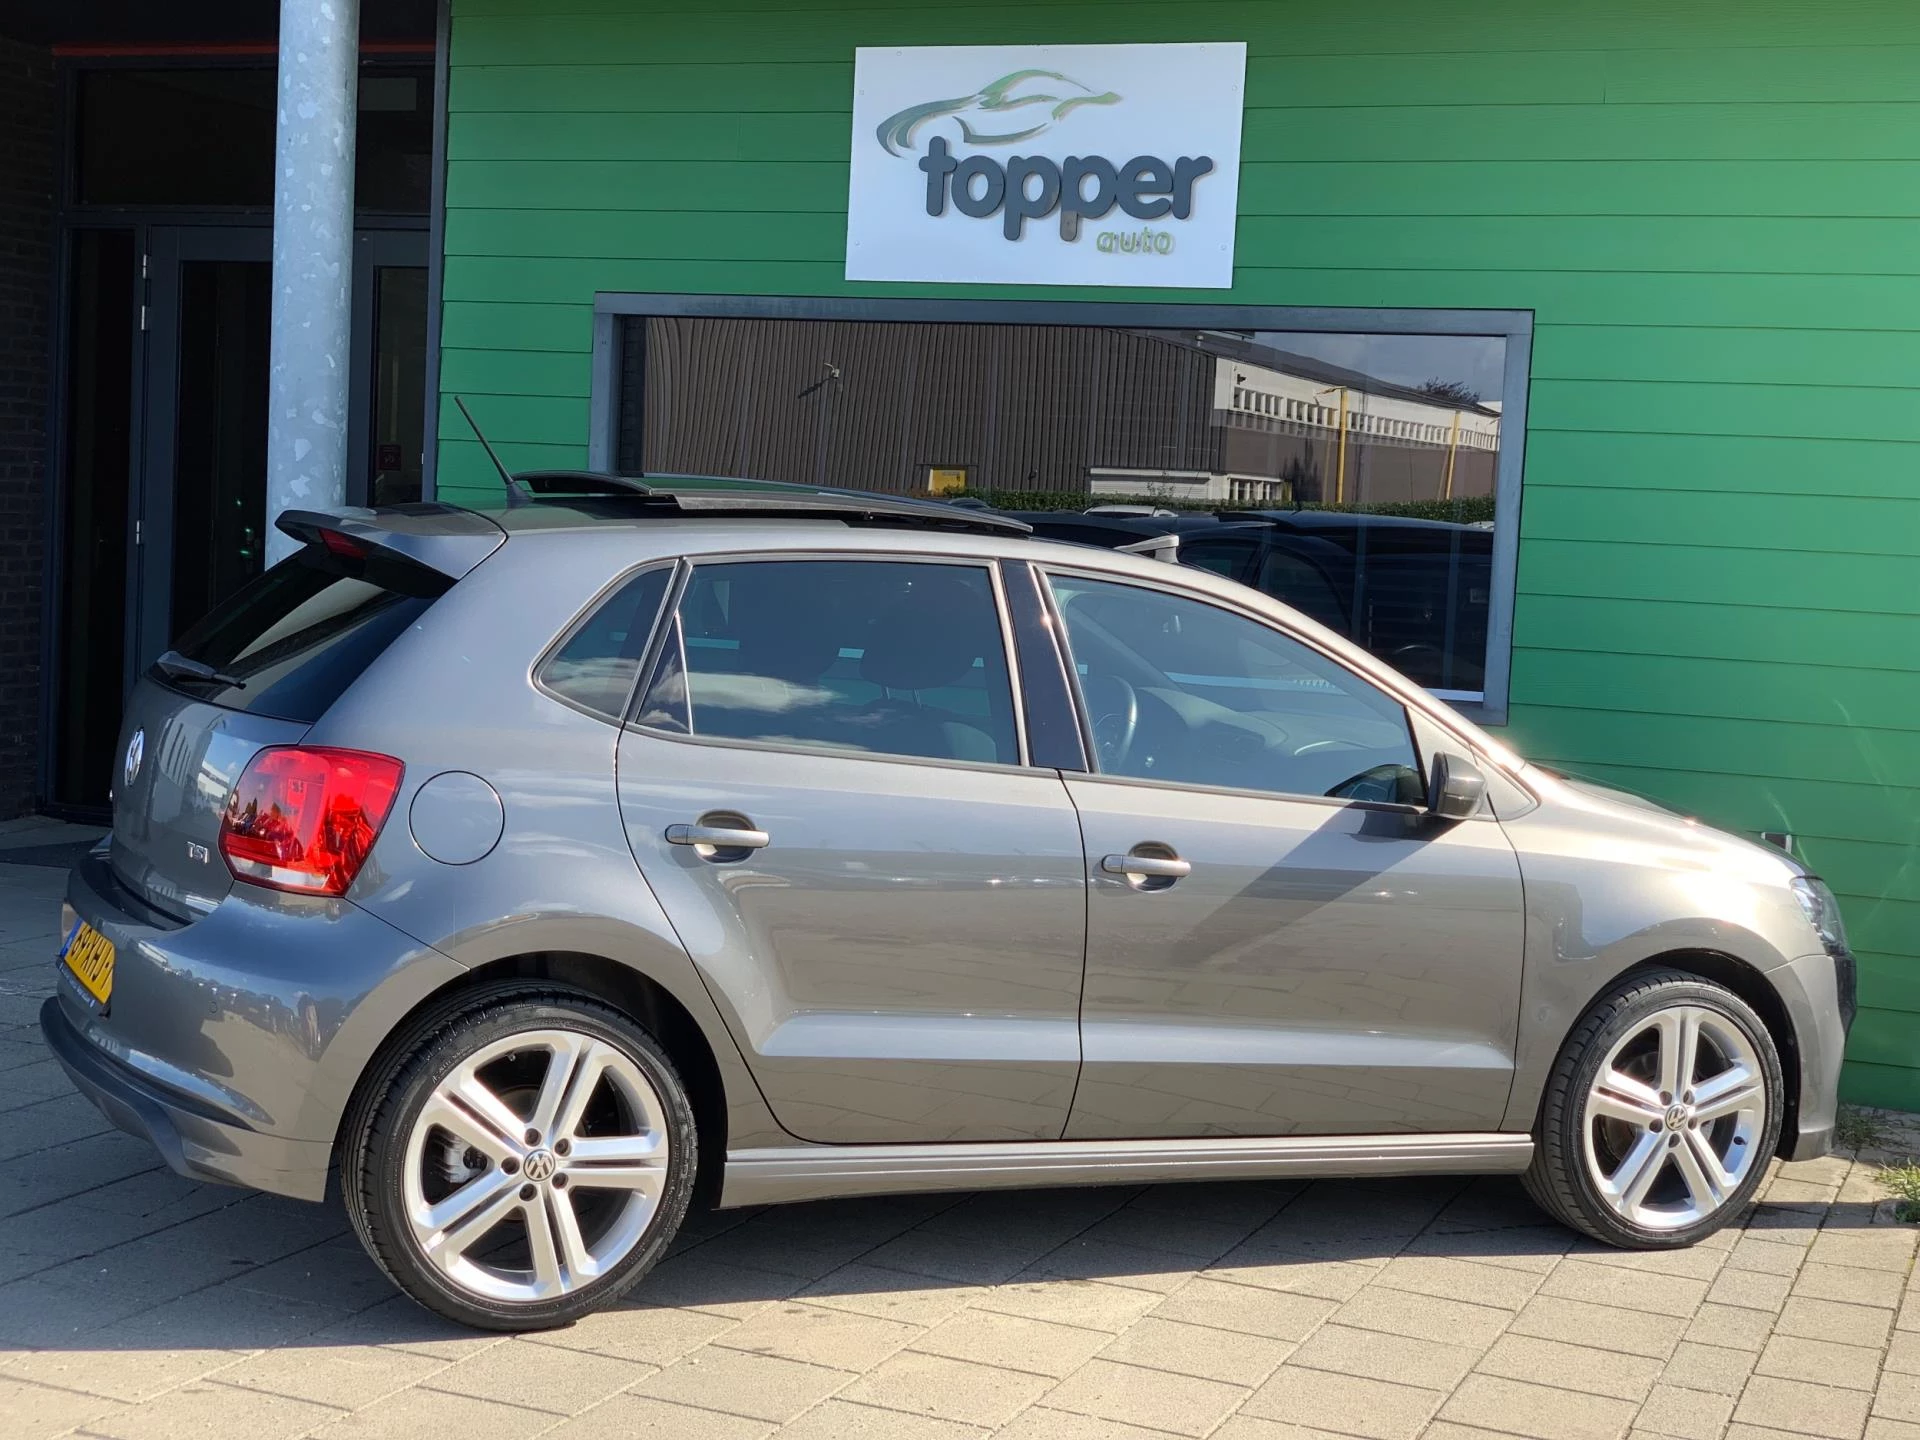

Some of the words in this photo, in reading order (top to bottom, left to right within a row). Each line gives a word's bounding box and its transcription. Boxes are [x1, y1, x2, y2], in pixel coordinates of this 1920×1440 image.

[918, 135, 1214, 242] topper
[1096, 226, 1173, 255] auto
[187, 841, 208, 864] TSI
